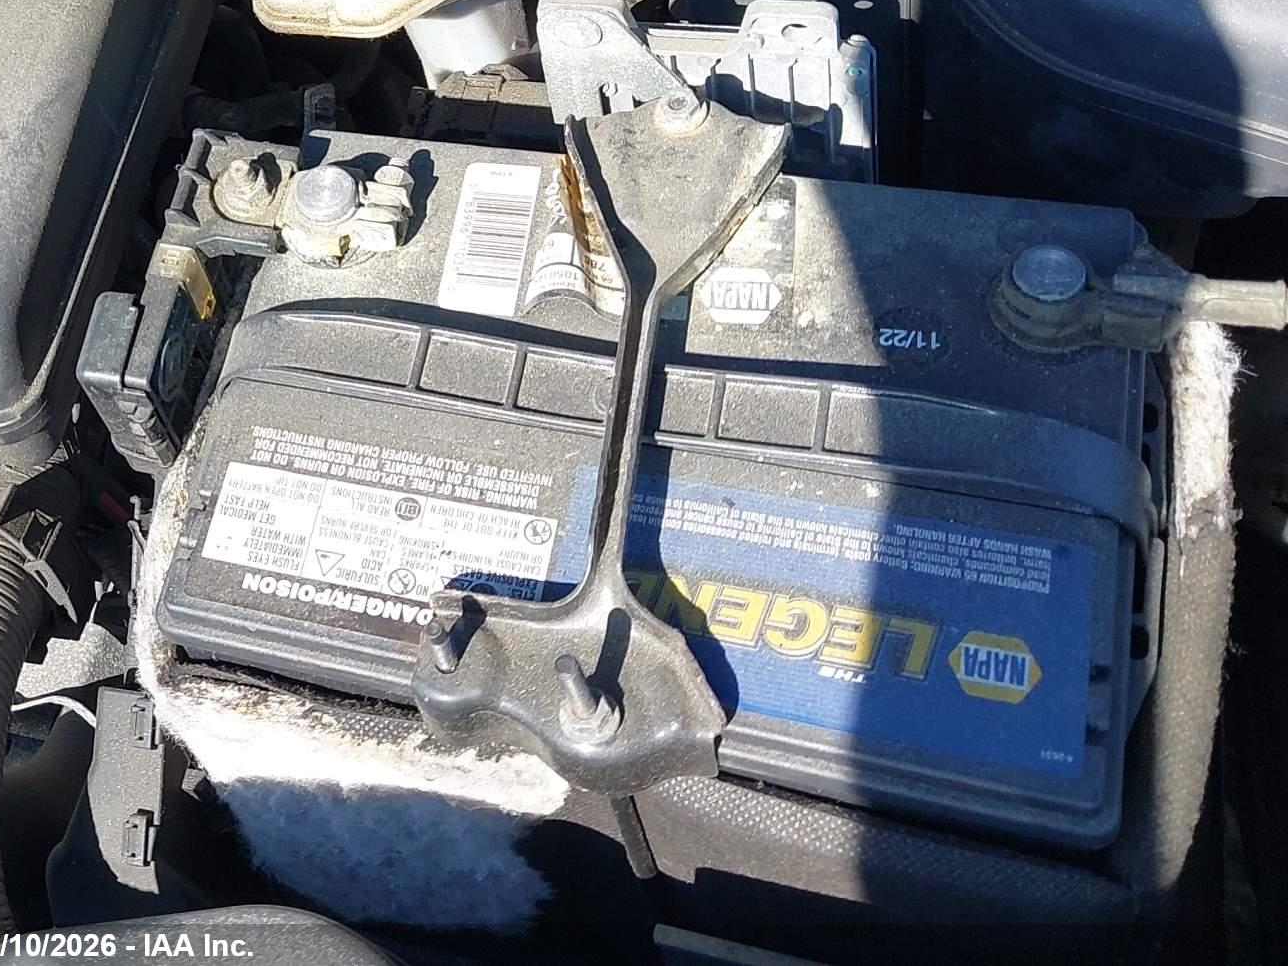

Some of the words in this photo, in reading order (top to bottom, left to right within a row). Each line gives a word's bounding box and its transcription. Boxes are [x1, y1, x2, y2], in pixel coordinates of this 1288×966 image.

[710, 282, 768, 310] NAPA
[879, 328, 940, 349] 11/22
[250, 425, 326, 448] INSTRUCTIONS.
[254, 438, 276, 452] FOR
[326, 438, 380, 458] CHARGING
[250, 449, 272, 462] NOT
[272, 452, 288, 466] DO
[276, 440, 355, 466] RECOMMENDED
[381, 448, 424, 464] PROPER
[330, 464, 346, 476] OR
[356, 456, 378, 470] NOT
[424, 454, 470, 474] FOLLOW
[346, 466, 406, 488] EXPLOSION
[446, 472, 463, 486] OR
[500, 468, 554, 488] INVERTED
[438, 484, 452, 496] OF
[454, 486, 480, 501] RISK
[464, 475, 540, 497] DISASSEMBLE
[330, 486, 392, 504] INSTRUCTIONS
[482, 489, 538, 510] WARNING:
[248, 497, 270, 512] HELP
[368, 504, 390, 517] READ
[673, 500, 682, 511] to
[683, 500, 728, 518] California
[218, 504, 256, 522] MEDICAL
[258, 514, 276, 525] GET
[664, 509, 682, 521] and
[683, 511, 714, 526] cancer
[730, 508, 740, 520] of
[742, 510, 766, 524] State
[716, 516, 744, 531] cause
[745, 522, 755, 534] to
[767, 515, 783, 527] the
[785, 517, 794, 529] to
[796, 518, 828, 532] known
[250, 526, 280, 542] WATER
[682, 520, 737, 541] accessories
[756, 522, 804, 543] California
[804, 530, 816, 544] of
[828, 525, 879, 541] chemicals
[282, 532, 306, 546] WITH
[738, 532, 772, 548] related
[773, 537, 792, 550] and
[816, 533, 841, 548] State
[843, 538, 858, 550] the
[859, 541, 872, 552] to
[880, 534, 906, 546] other
[909, 538, 945, 553] contain
[948, 534, 982, 548] AFTER
[984, 538, 1019, 554] HANDS
[242, 537, 303, 560] IMMEDIATELY
[370, 549, 386, 560] CAN
[872, 542, 905, 557] known
[948, 544, 970, 556] also
[1020, 544, 1052, 560] WASH
[247, 550, 270, 566] EYES
[271, 555, 300, 571] FLUSH
[361, 558, 383, 572] ACID
[873, 552, 908, 571] Battery
[335, 568, 380, 586] SULFURIC
[910, 560, 962, 580] WARNING:
[963, 570, 978, 582] 65
[416, 584, 430, 597] NO
[978, 572, 1050, 594] PROPOSITION
[241, 572, 434, 625] DANGER/POISON
[962, 646, 1027, 688] NAPA
[817, 666, 866, 685] THE
